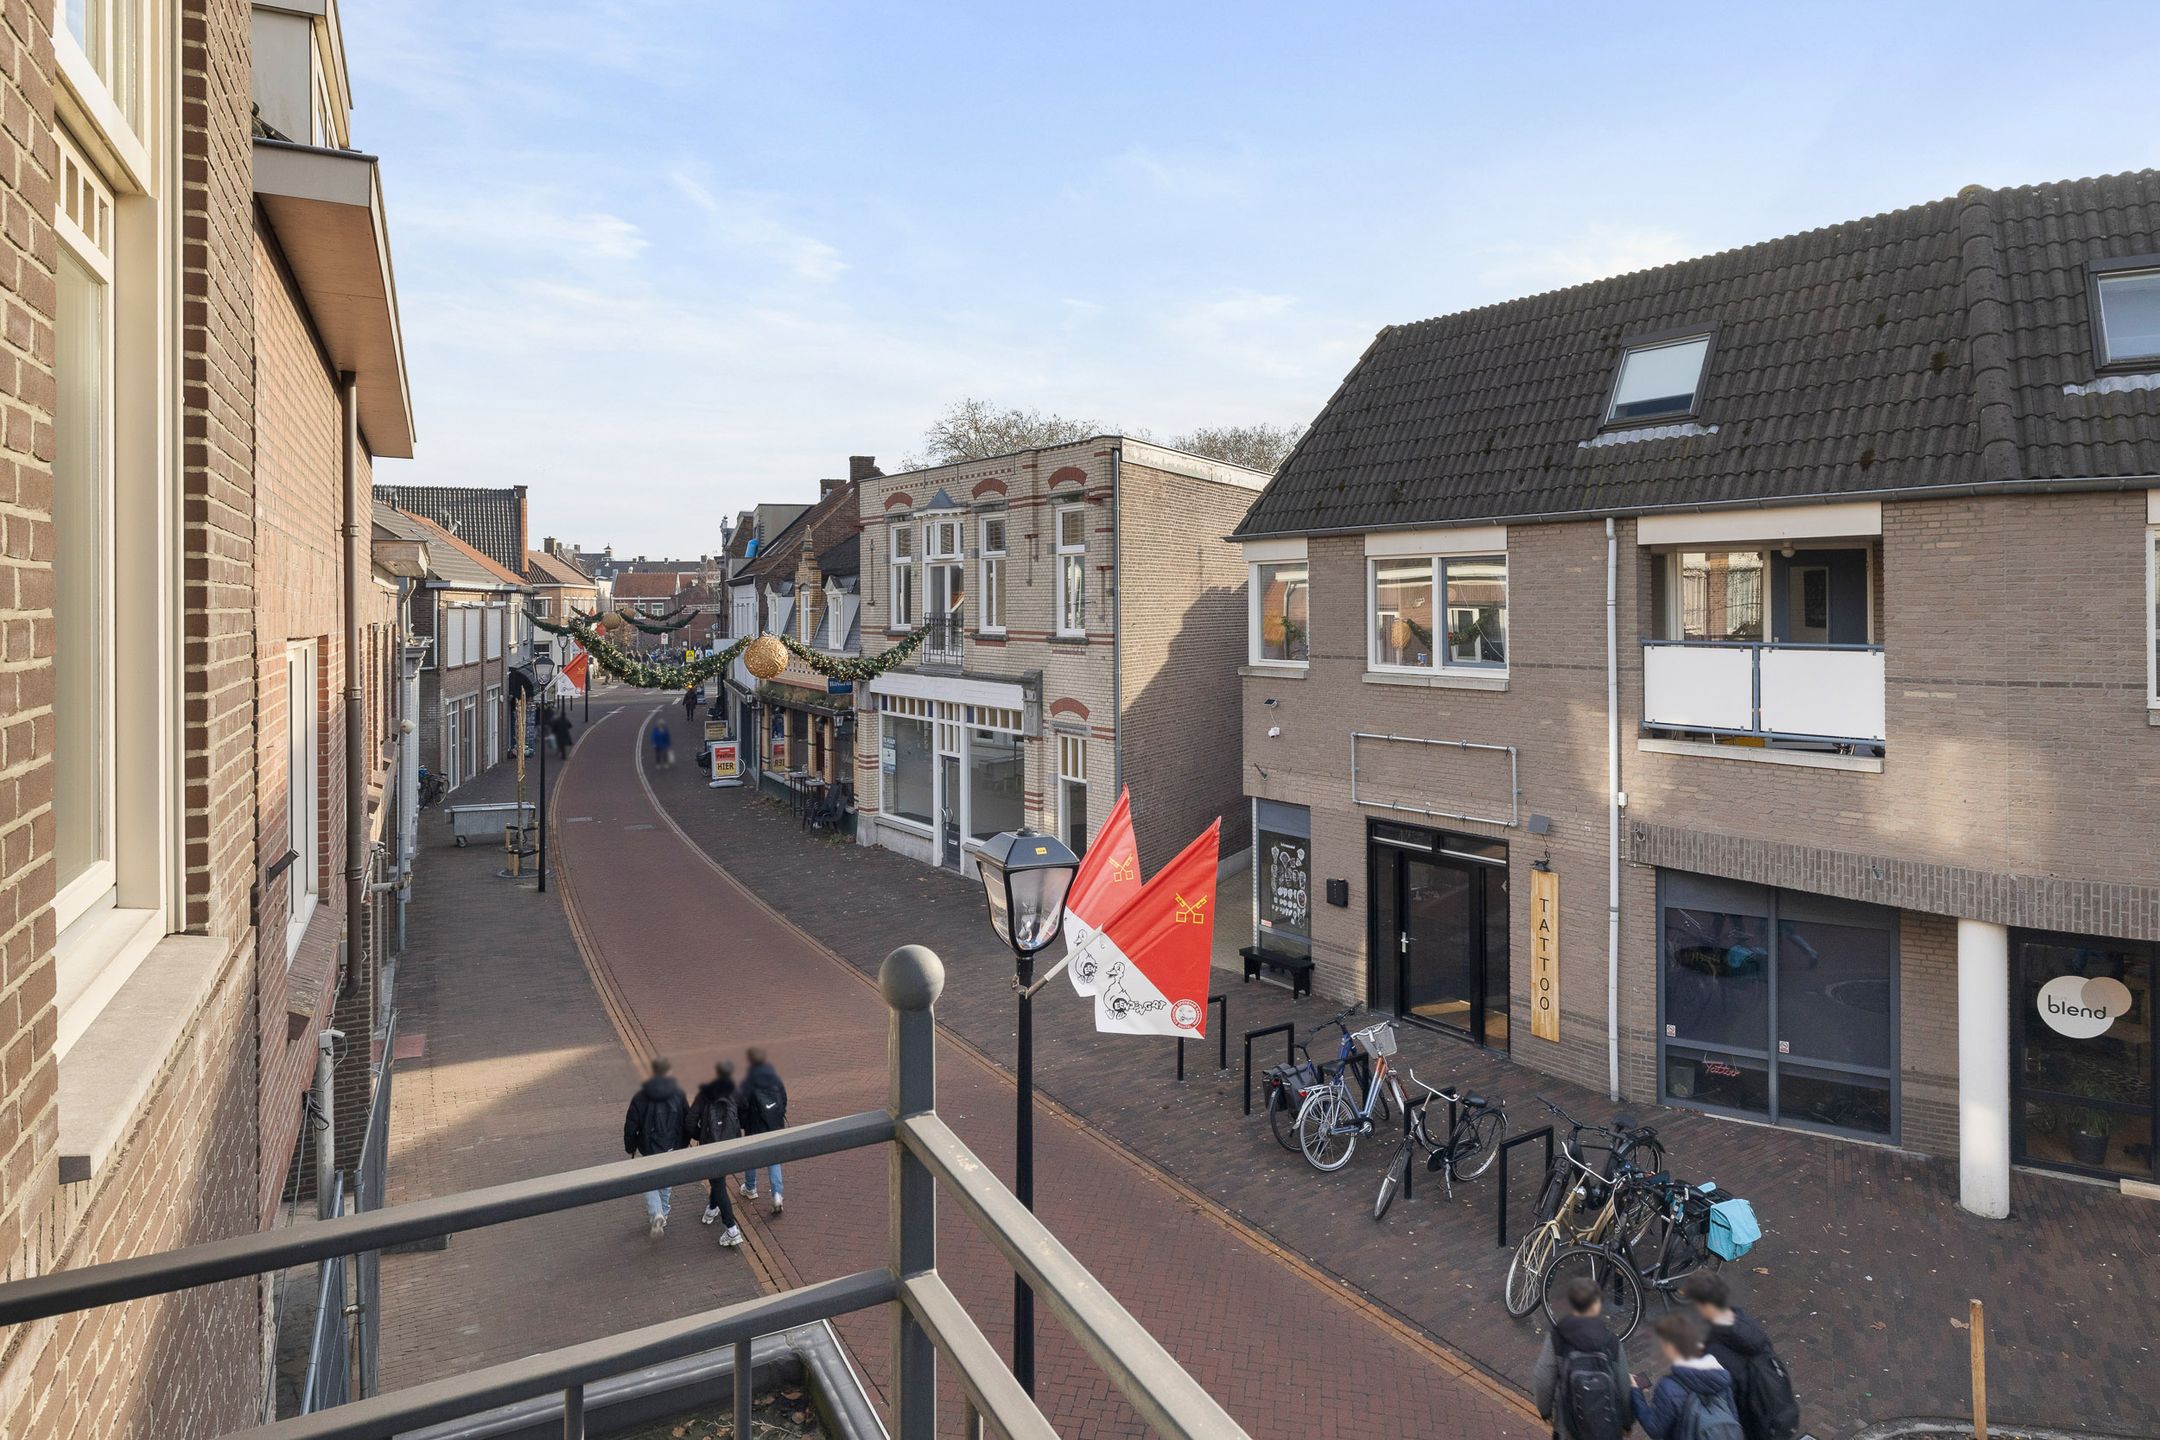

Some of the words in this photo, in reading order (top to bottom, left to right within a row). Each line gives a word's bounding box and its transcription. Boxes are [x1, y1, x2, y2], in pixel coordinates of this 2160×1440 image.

[717, 762, 734, 770] HIER
[1539, 897, 1550, 1011] TATTOO
[2048, 994, 2107, 1020] blend
